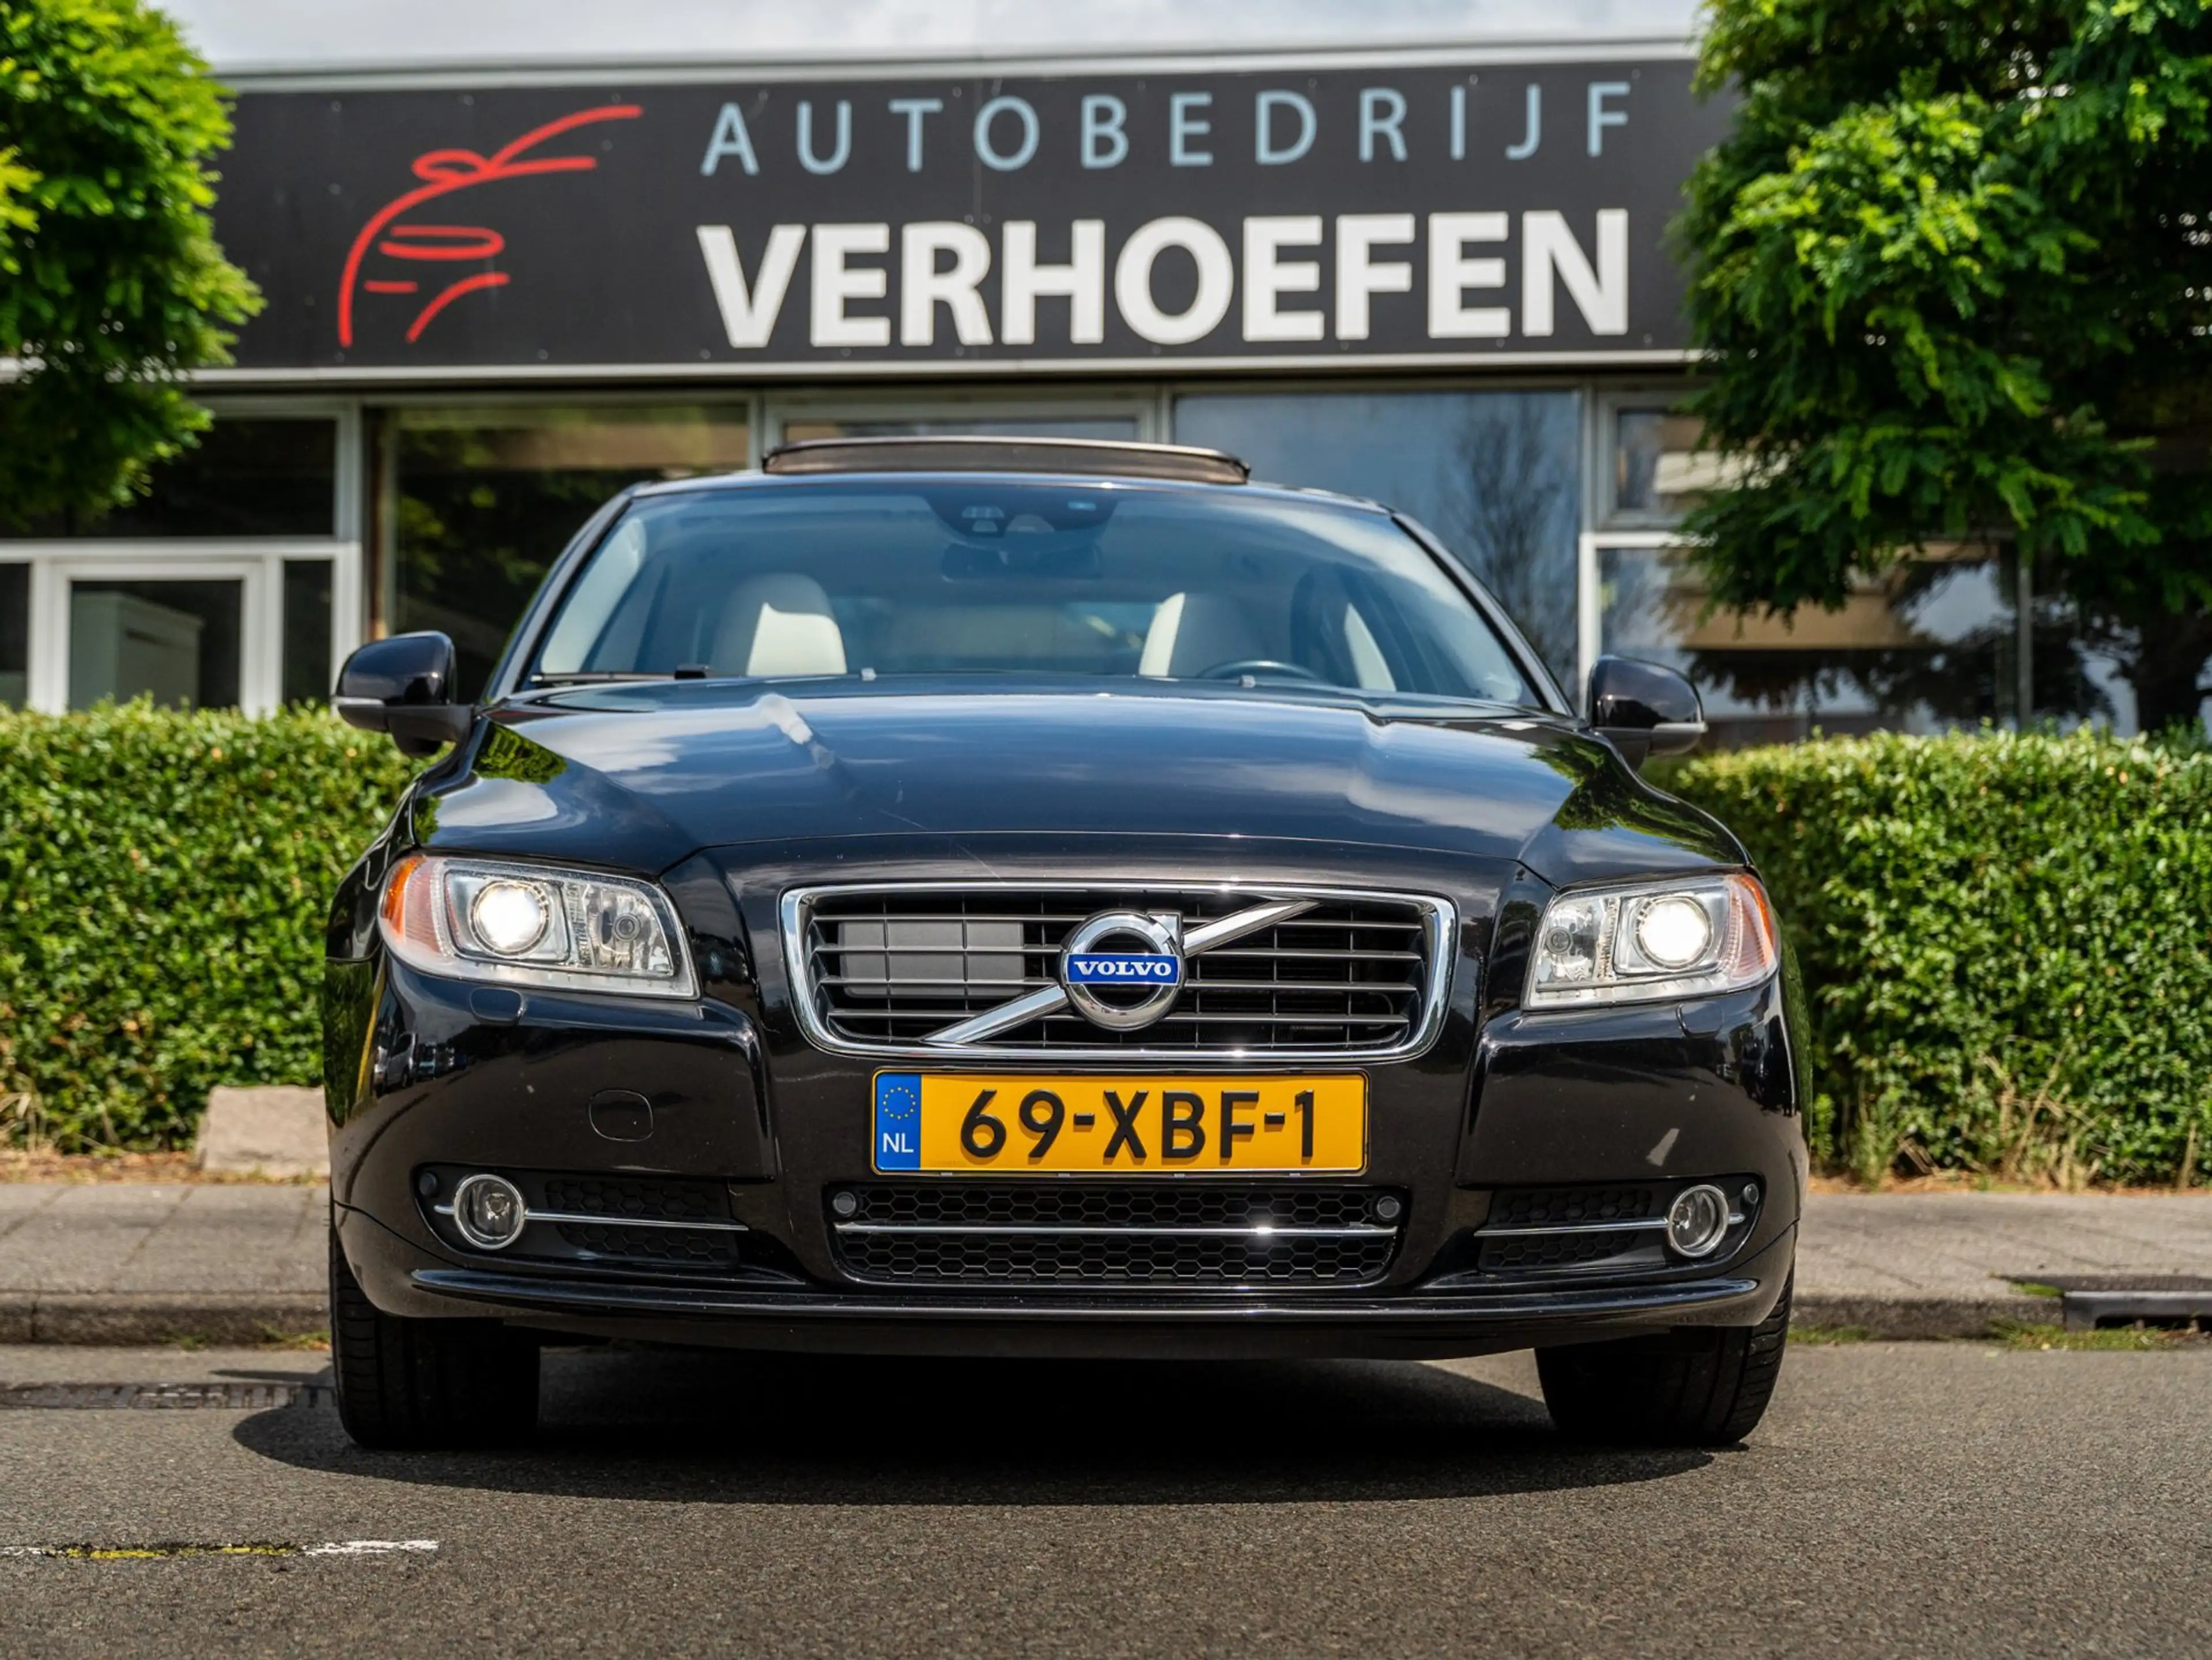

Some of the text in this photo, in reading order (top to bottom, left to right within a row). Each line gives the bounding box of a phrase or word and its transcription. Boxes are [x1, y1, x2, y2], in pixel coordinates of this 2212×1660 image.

[700, 81, 1632, 176] AUTOBEDRIJF
[696, 208, 1630, 348] VERHOEFEN
[1074, 961, 1172, 976] VOLVO
[882, 1133, 914, 1153] NL
[960, 1089, 1315, 1159] 69-XBF-1
